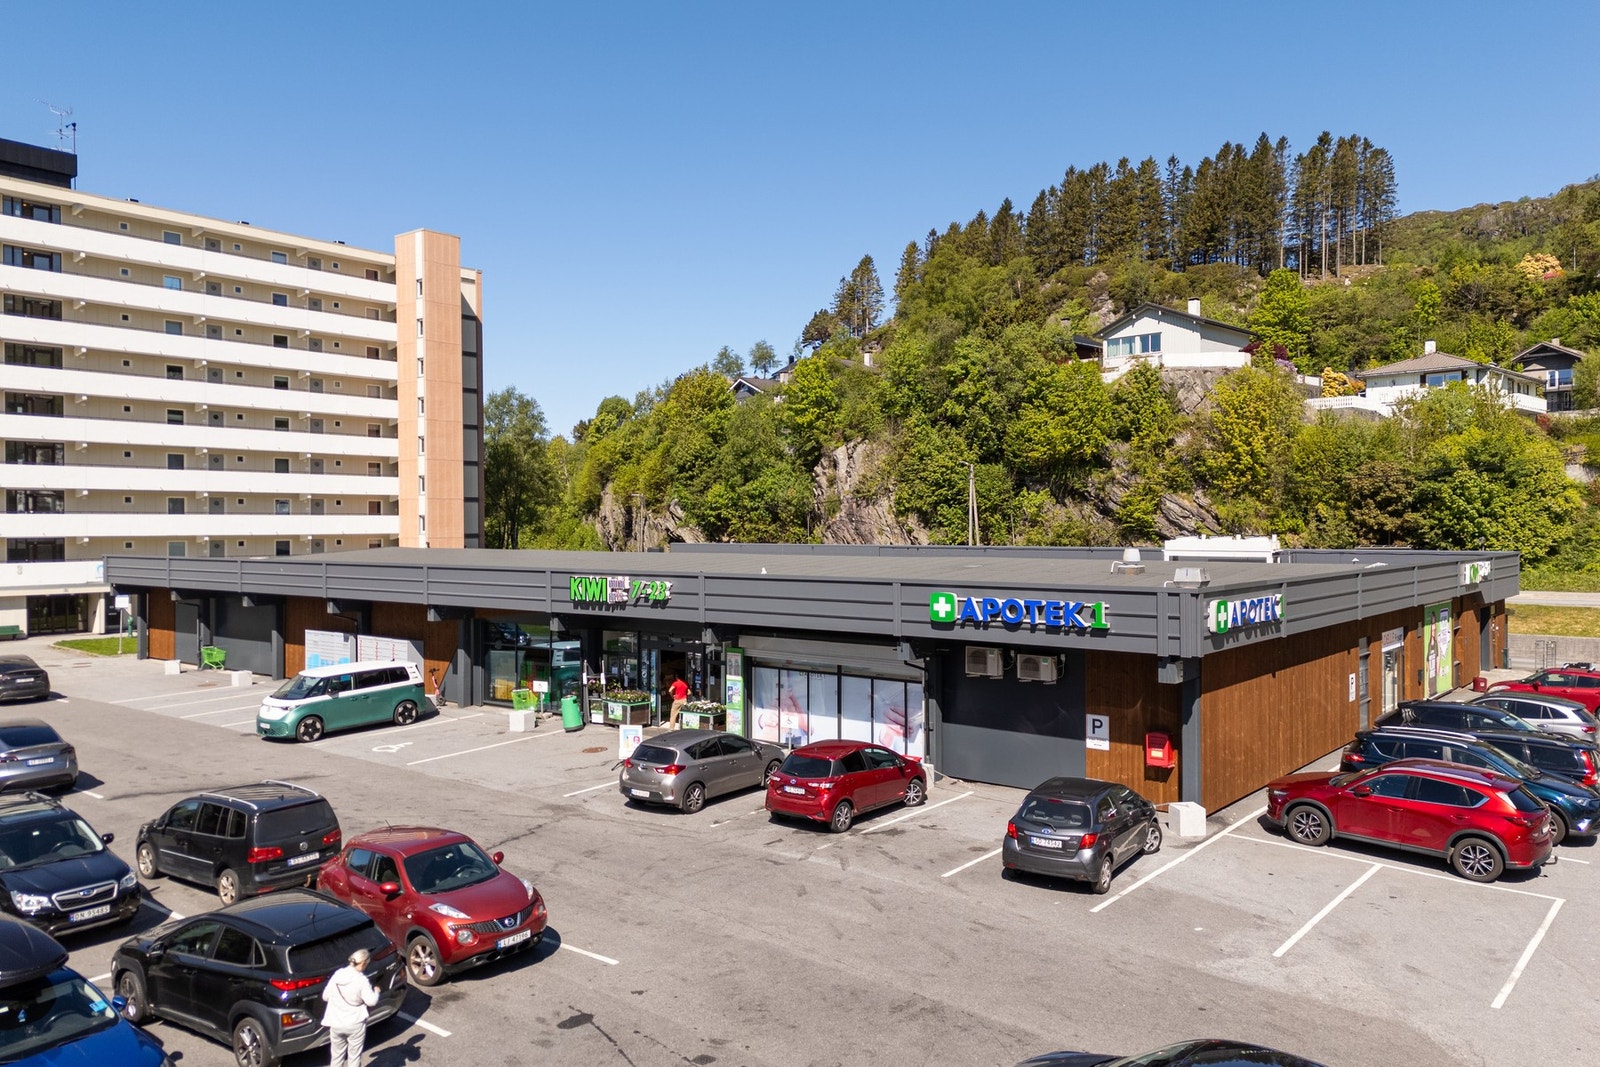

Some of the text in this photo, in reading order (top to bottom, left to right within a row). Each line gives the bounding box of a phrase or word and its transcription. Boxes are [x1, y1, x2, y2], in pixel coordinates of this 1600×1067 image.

[569, 576, 608, 602] KIWI
[959, 596, 1111, 629] APOTEK 1
[1231, 596, 1278, 627] APOTEK
[1091, 718, 1104, 735] P
